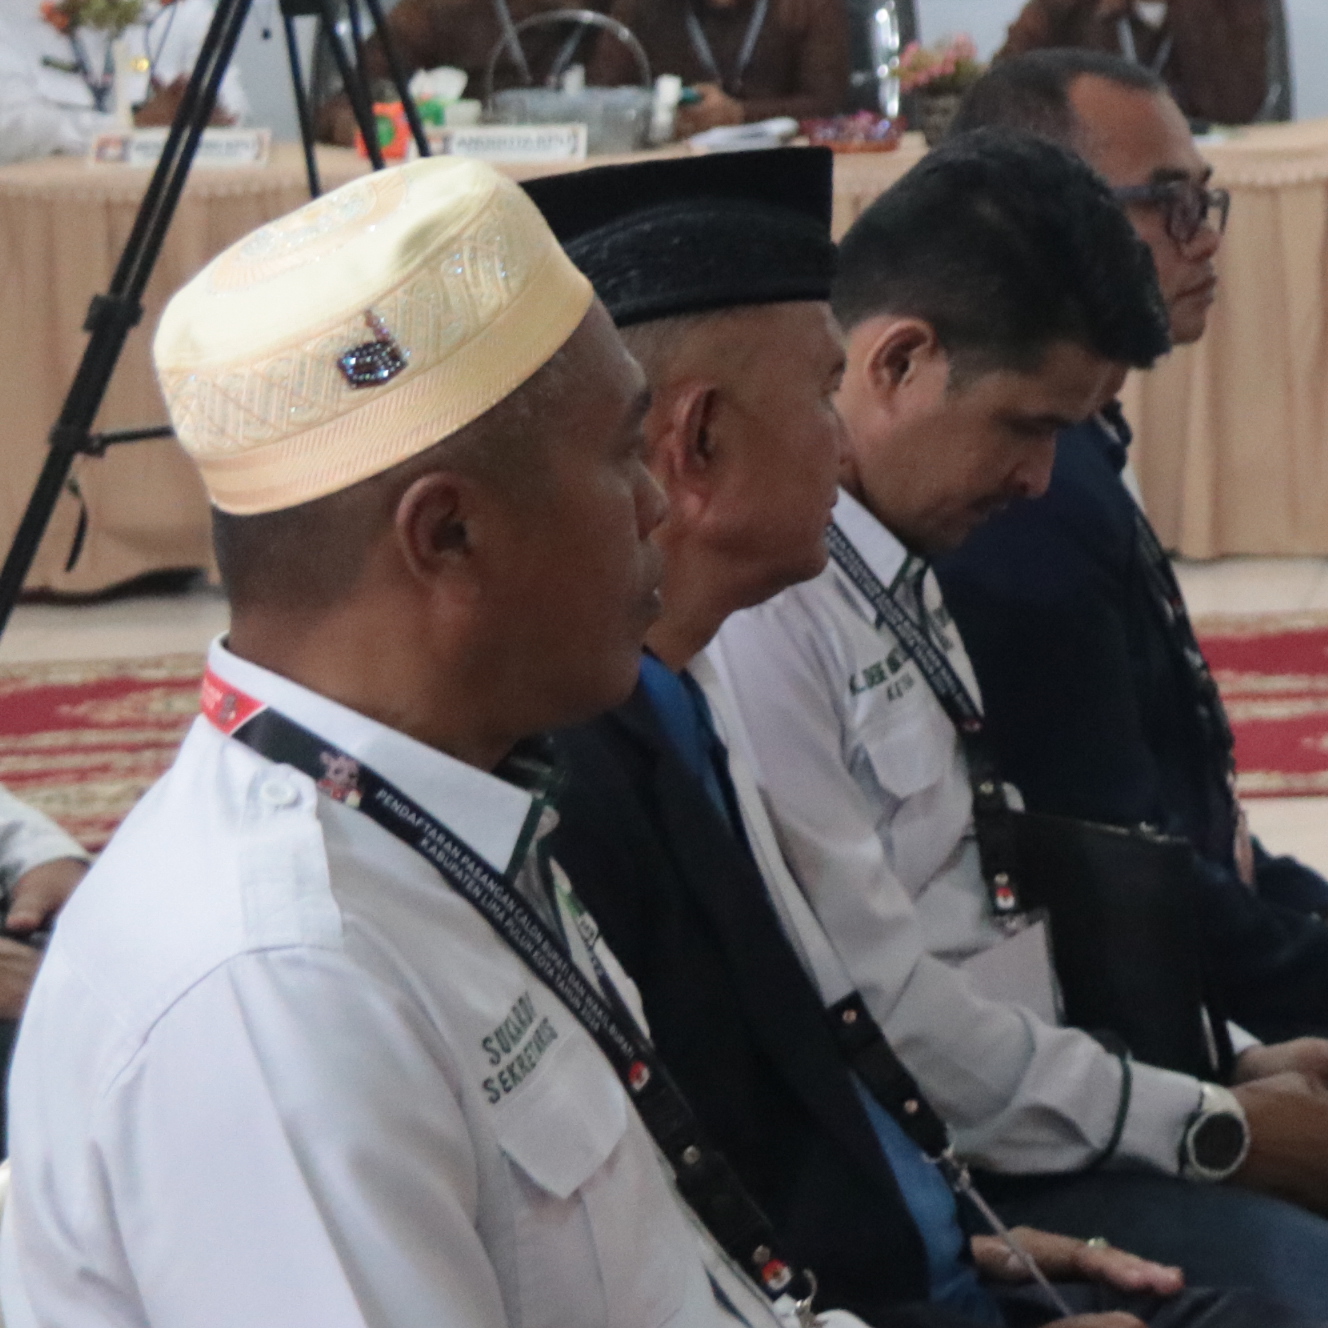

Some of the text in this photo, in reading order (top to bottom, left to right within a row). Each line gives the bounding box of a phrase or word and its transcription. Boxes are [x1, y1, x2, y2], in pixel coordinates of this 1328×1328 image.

[375, 786, 462, 859] PENDAFTARAN
[458, 854, 519, 912] PASANGAN
[512, 907, 544, 945] CALON
[419, 836, 484, 898] KABUPATEN
[478, 891, 508, 923] LIMA
